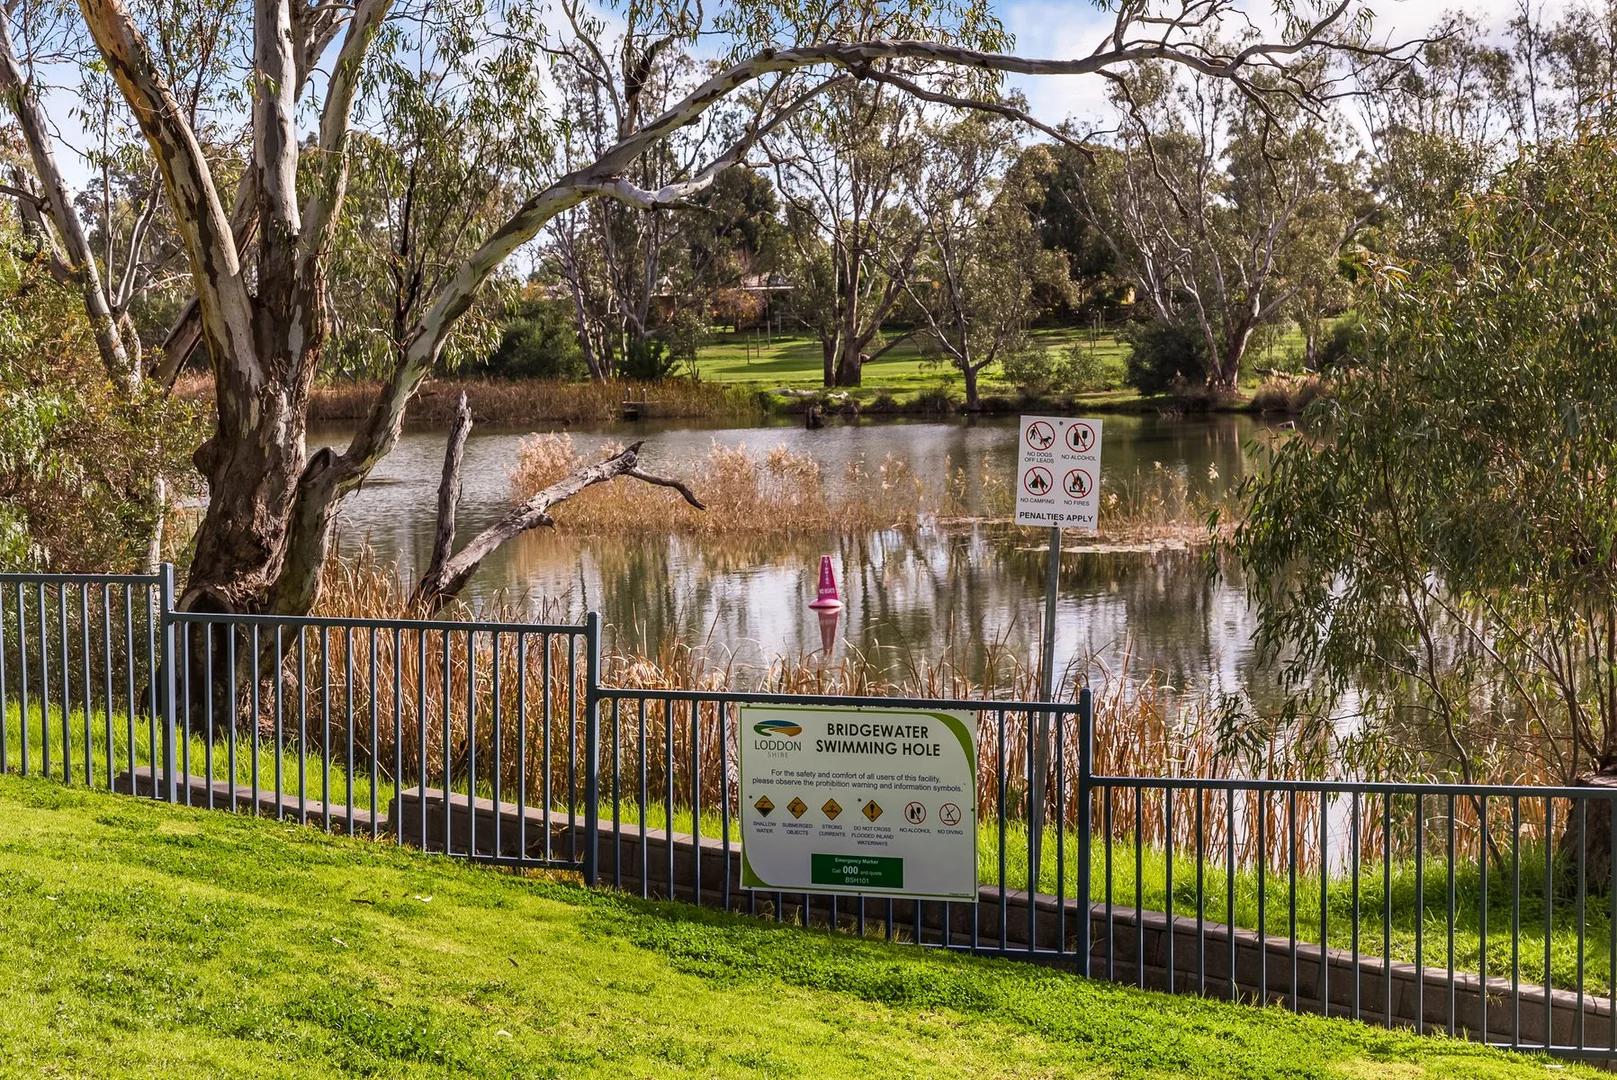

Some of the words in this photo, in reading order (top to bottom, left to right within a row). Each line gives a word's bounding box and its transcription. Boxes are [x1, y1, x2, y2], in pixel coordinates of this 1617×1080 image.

[1020, 512, 1064, 520] PENALTIES
[828, 723, 928, 738] BRIDGEWATER
[755, 740, 801, 751] LODDON
[816, 739, 897, 755] SWIMMING
[902, 743, 940, 756] HOLE
[796, 770, 816, 778] safety
[815, 780, 850, 788] prohibition
[852, 782, 878, 790] warning
[894, 783, 931, 791] information
[933, 784, 963, 792] symbols.
[843, 866, 858, 874] 000
